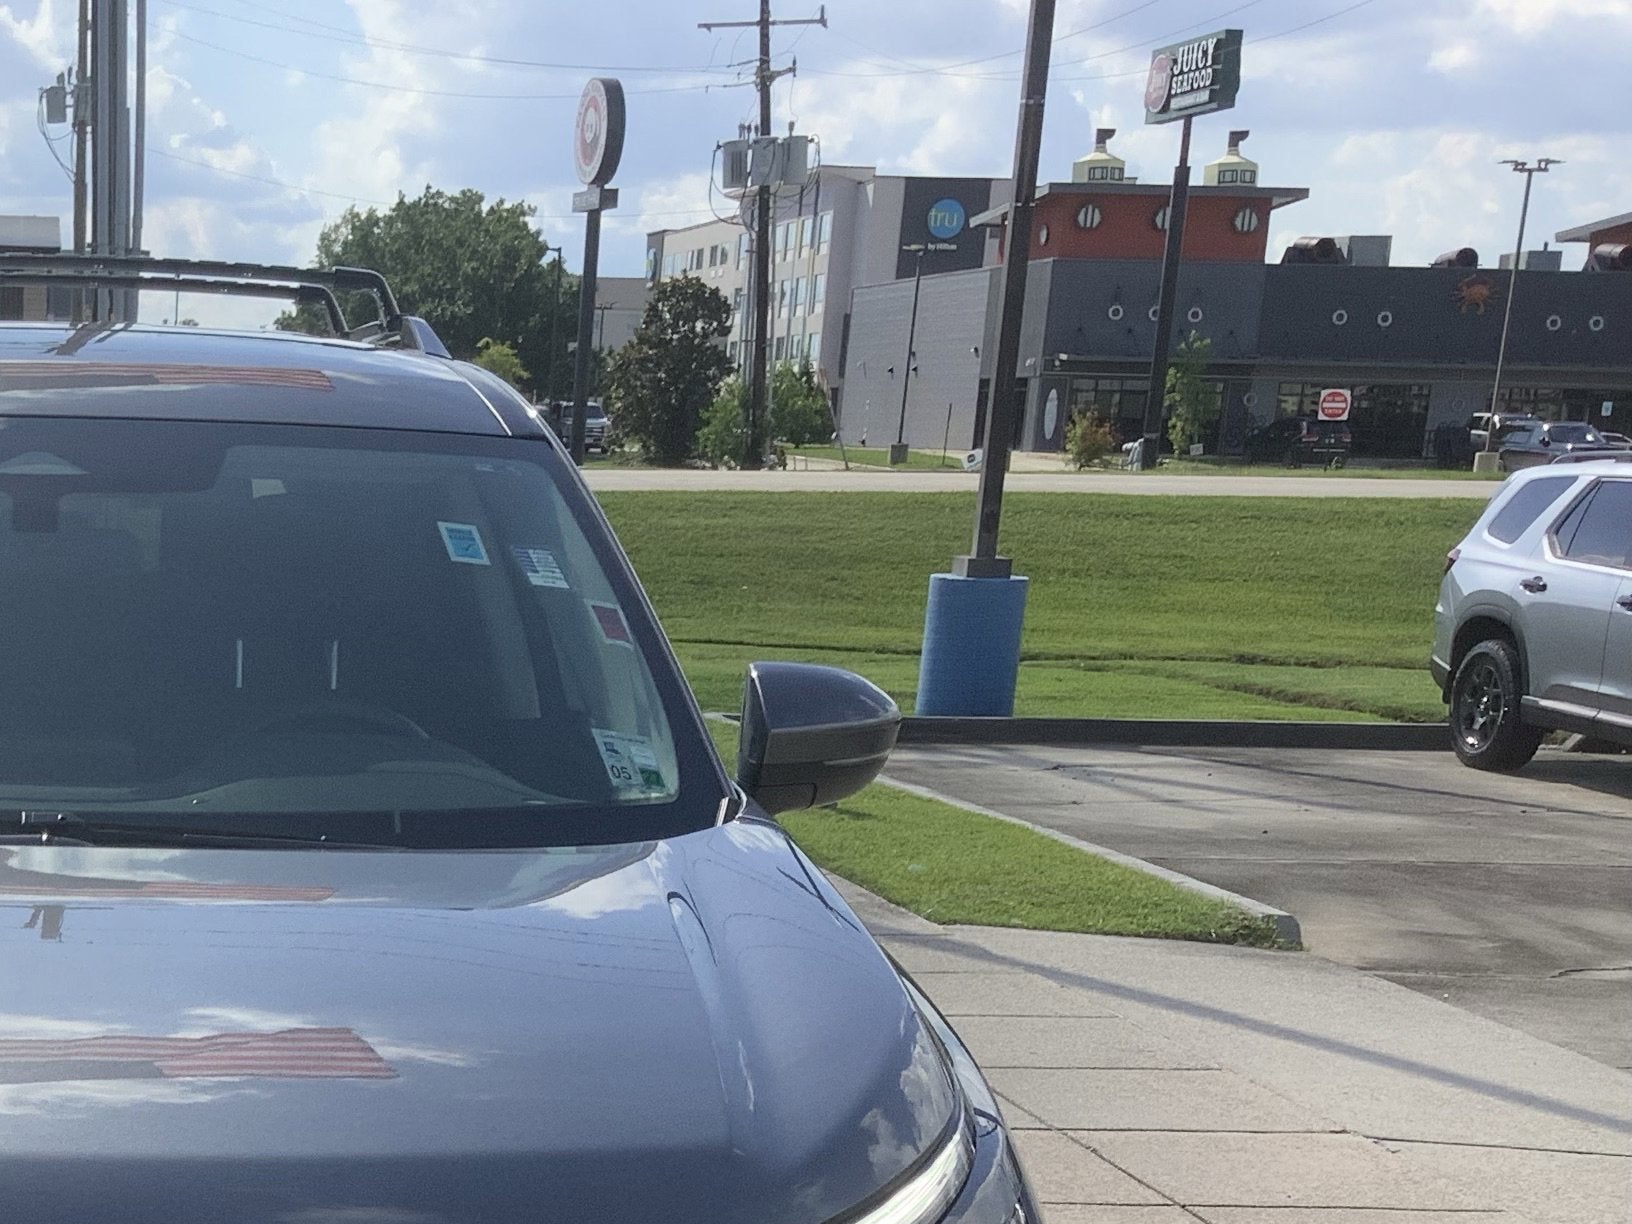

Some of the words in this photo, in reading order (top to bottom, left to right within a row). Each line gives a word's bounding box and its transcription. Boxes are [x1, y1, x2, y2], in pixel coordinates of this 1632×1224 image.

[1173, 37, 1217, 75] JUICY
[1171, 68, 1213, 95] SEAFOOD
[929, 207, 958, 228] tru
[610, 764, 632, 780] 05
